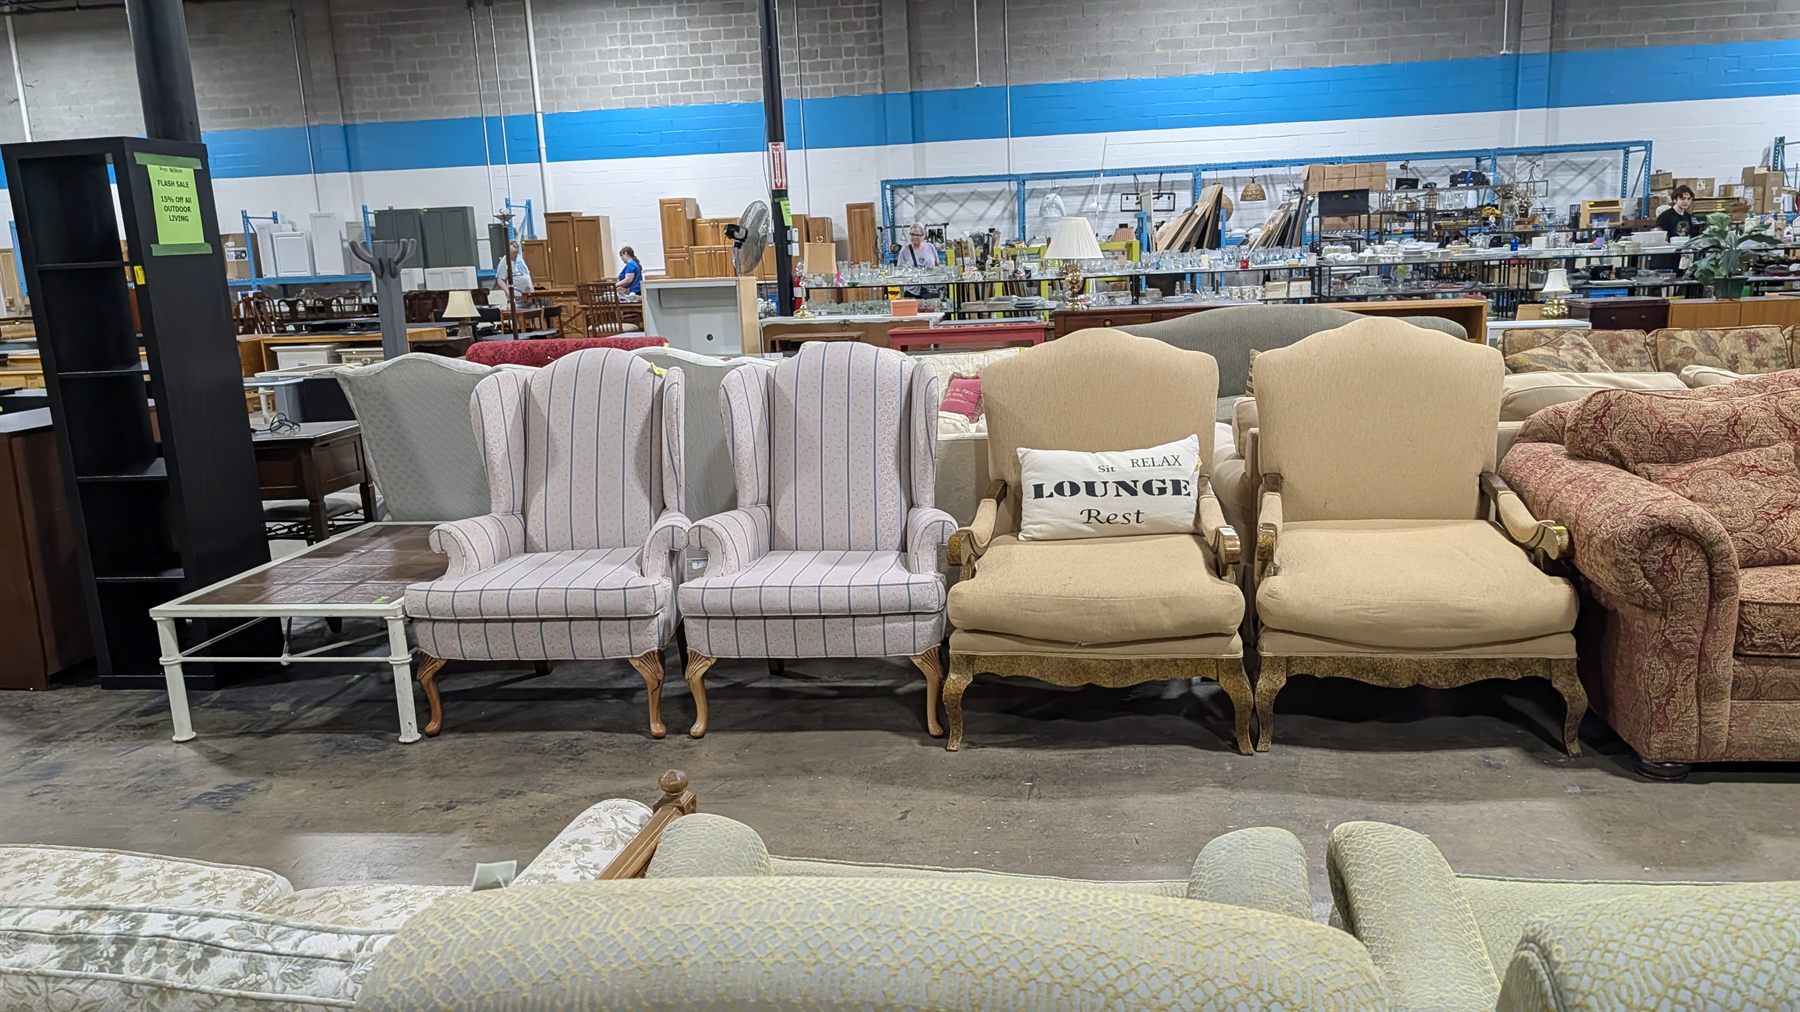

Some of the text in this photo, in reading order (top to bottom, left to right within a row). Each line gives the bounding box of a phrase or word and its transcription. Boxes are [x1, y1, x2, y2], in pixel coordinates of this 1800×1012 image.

[157, 180, 175, 188] FLASH
[163, 205, 192, 213] OUTDOOR
[1130, 455, 1183, 468] RELAX
[1098, 465, 1116, 473] Sit
[1032, 478, 1192, 500] LOUNGE
[1080, 508, 1146, 525] Rest
